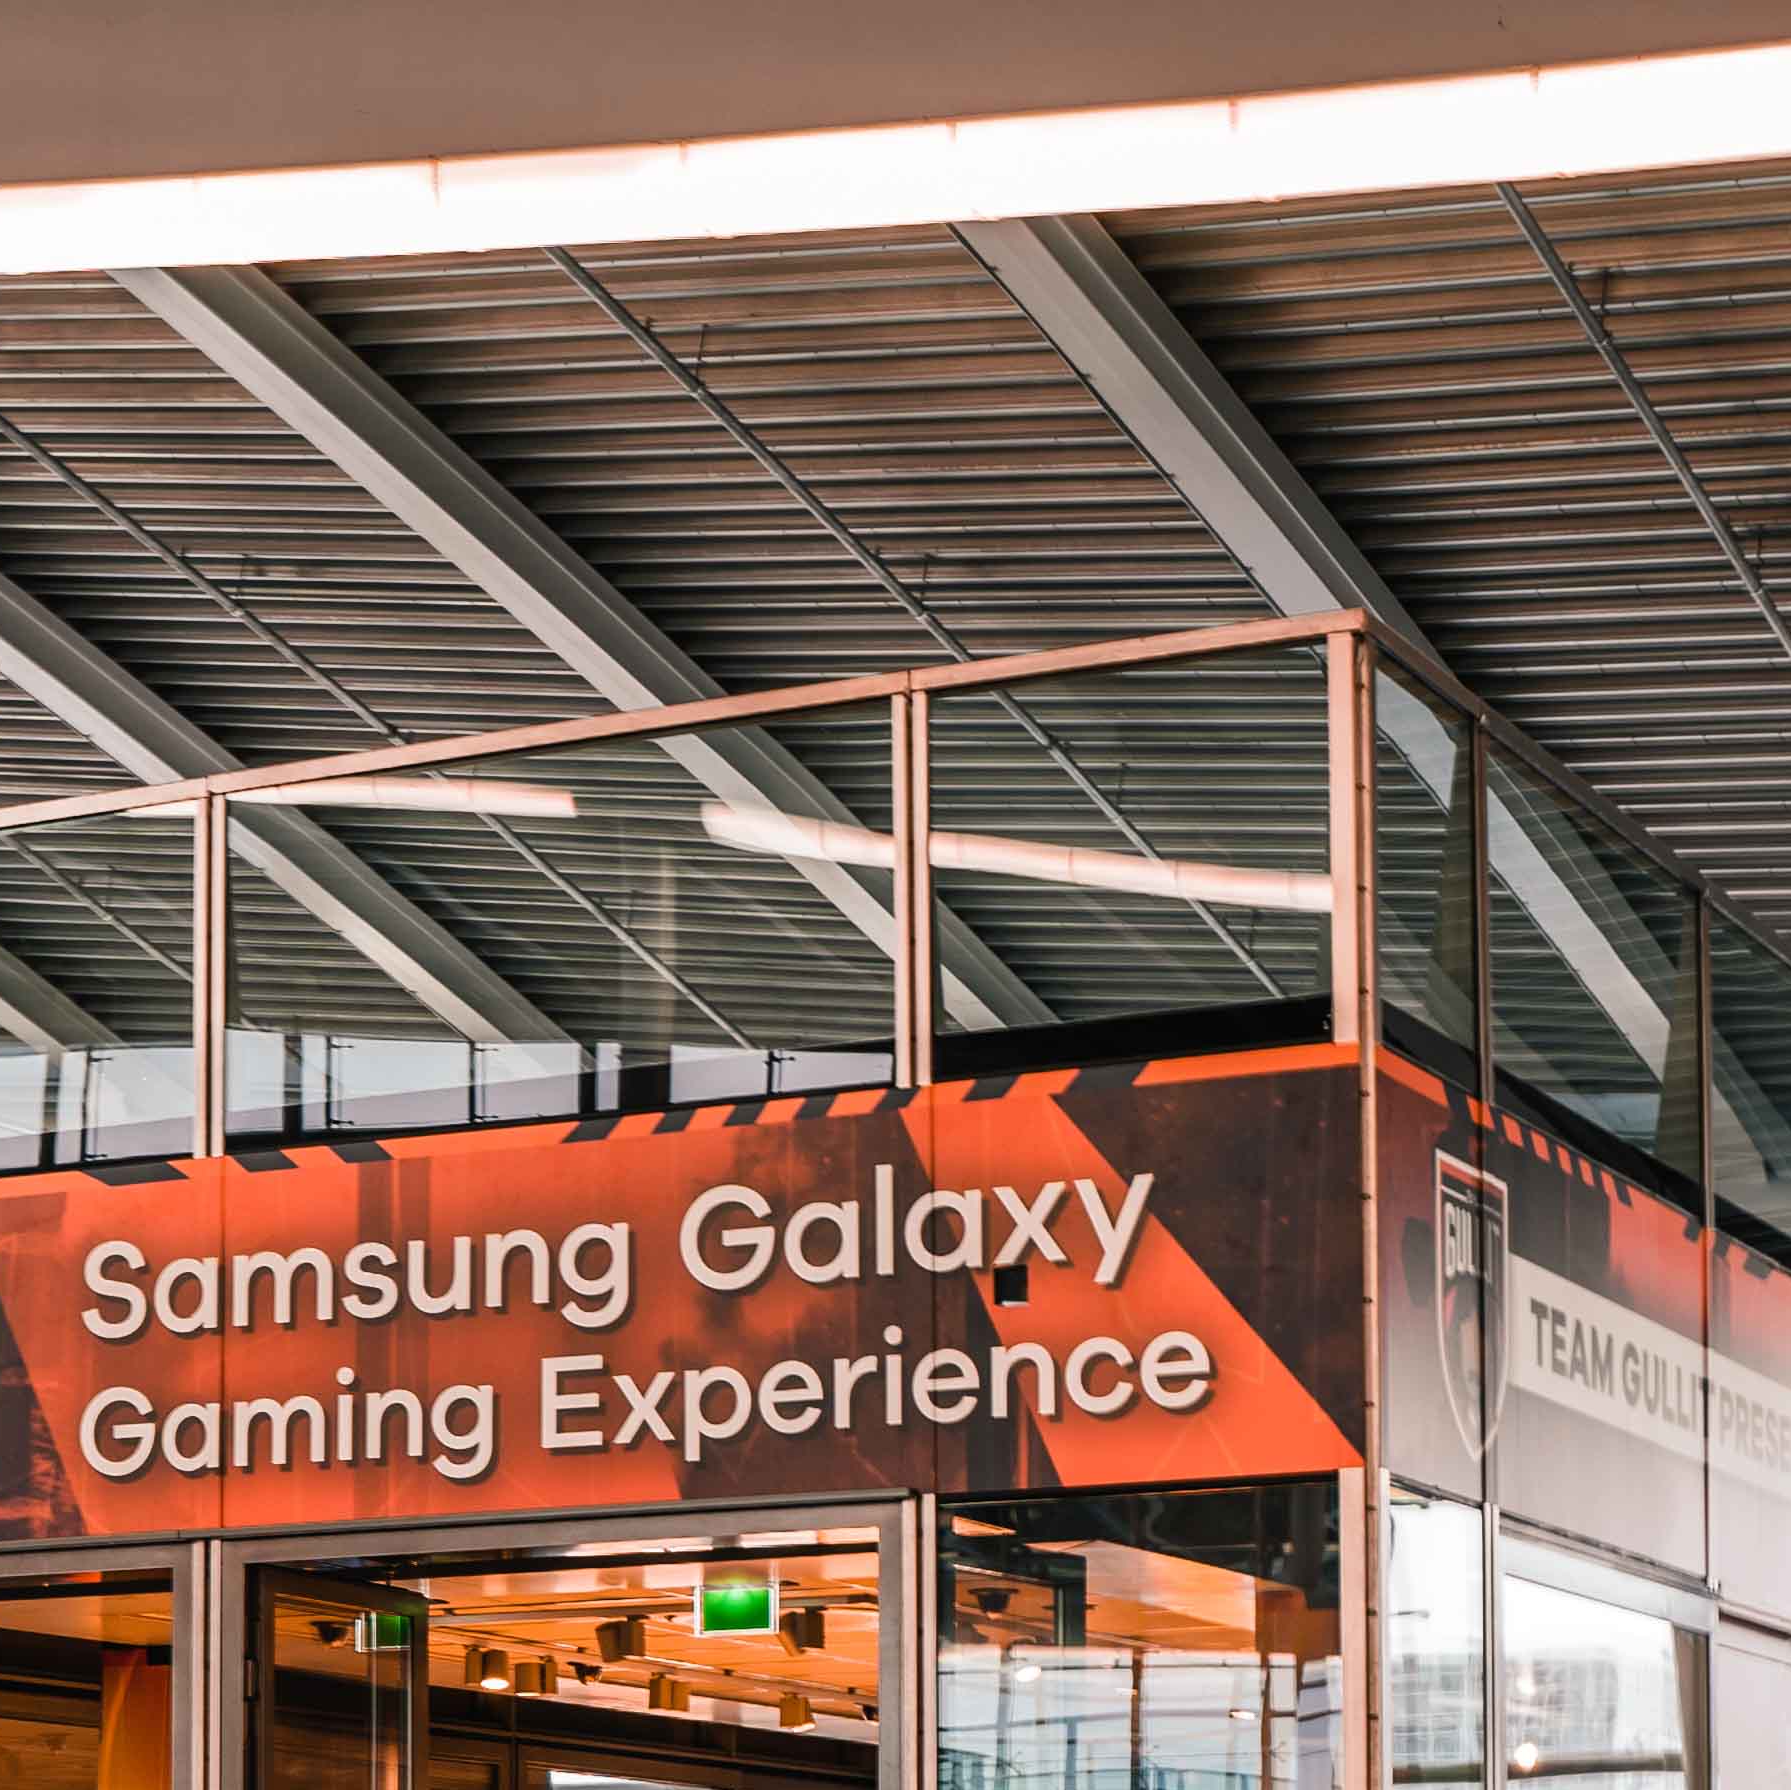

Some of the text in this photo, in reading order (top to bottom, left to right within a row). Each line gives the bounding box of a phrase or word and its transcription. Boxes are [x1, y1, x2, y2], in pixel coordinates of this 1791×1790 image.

[81, 1163, 1154, 1339] Samsung Galaxy
[78, 1325, 1210, 1479] Gaming Experience
[1531, 1297, 1614, 1399] TEAM
[1622, 1341, 1714, 1440] GULLIT
